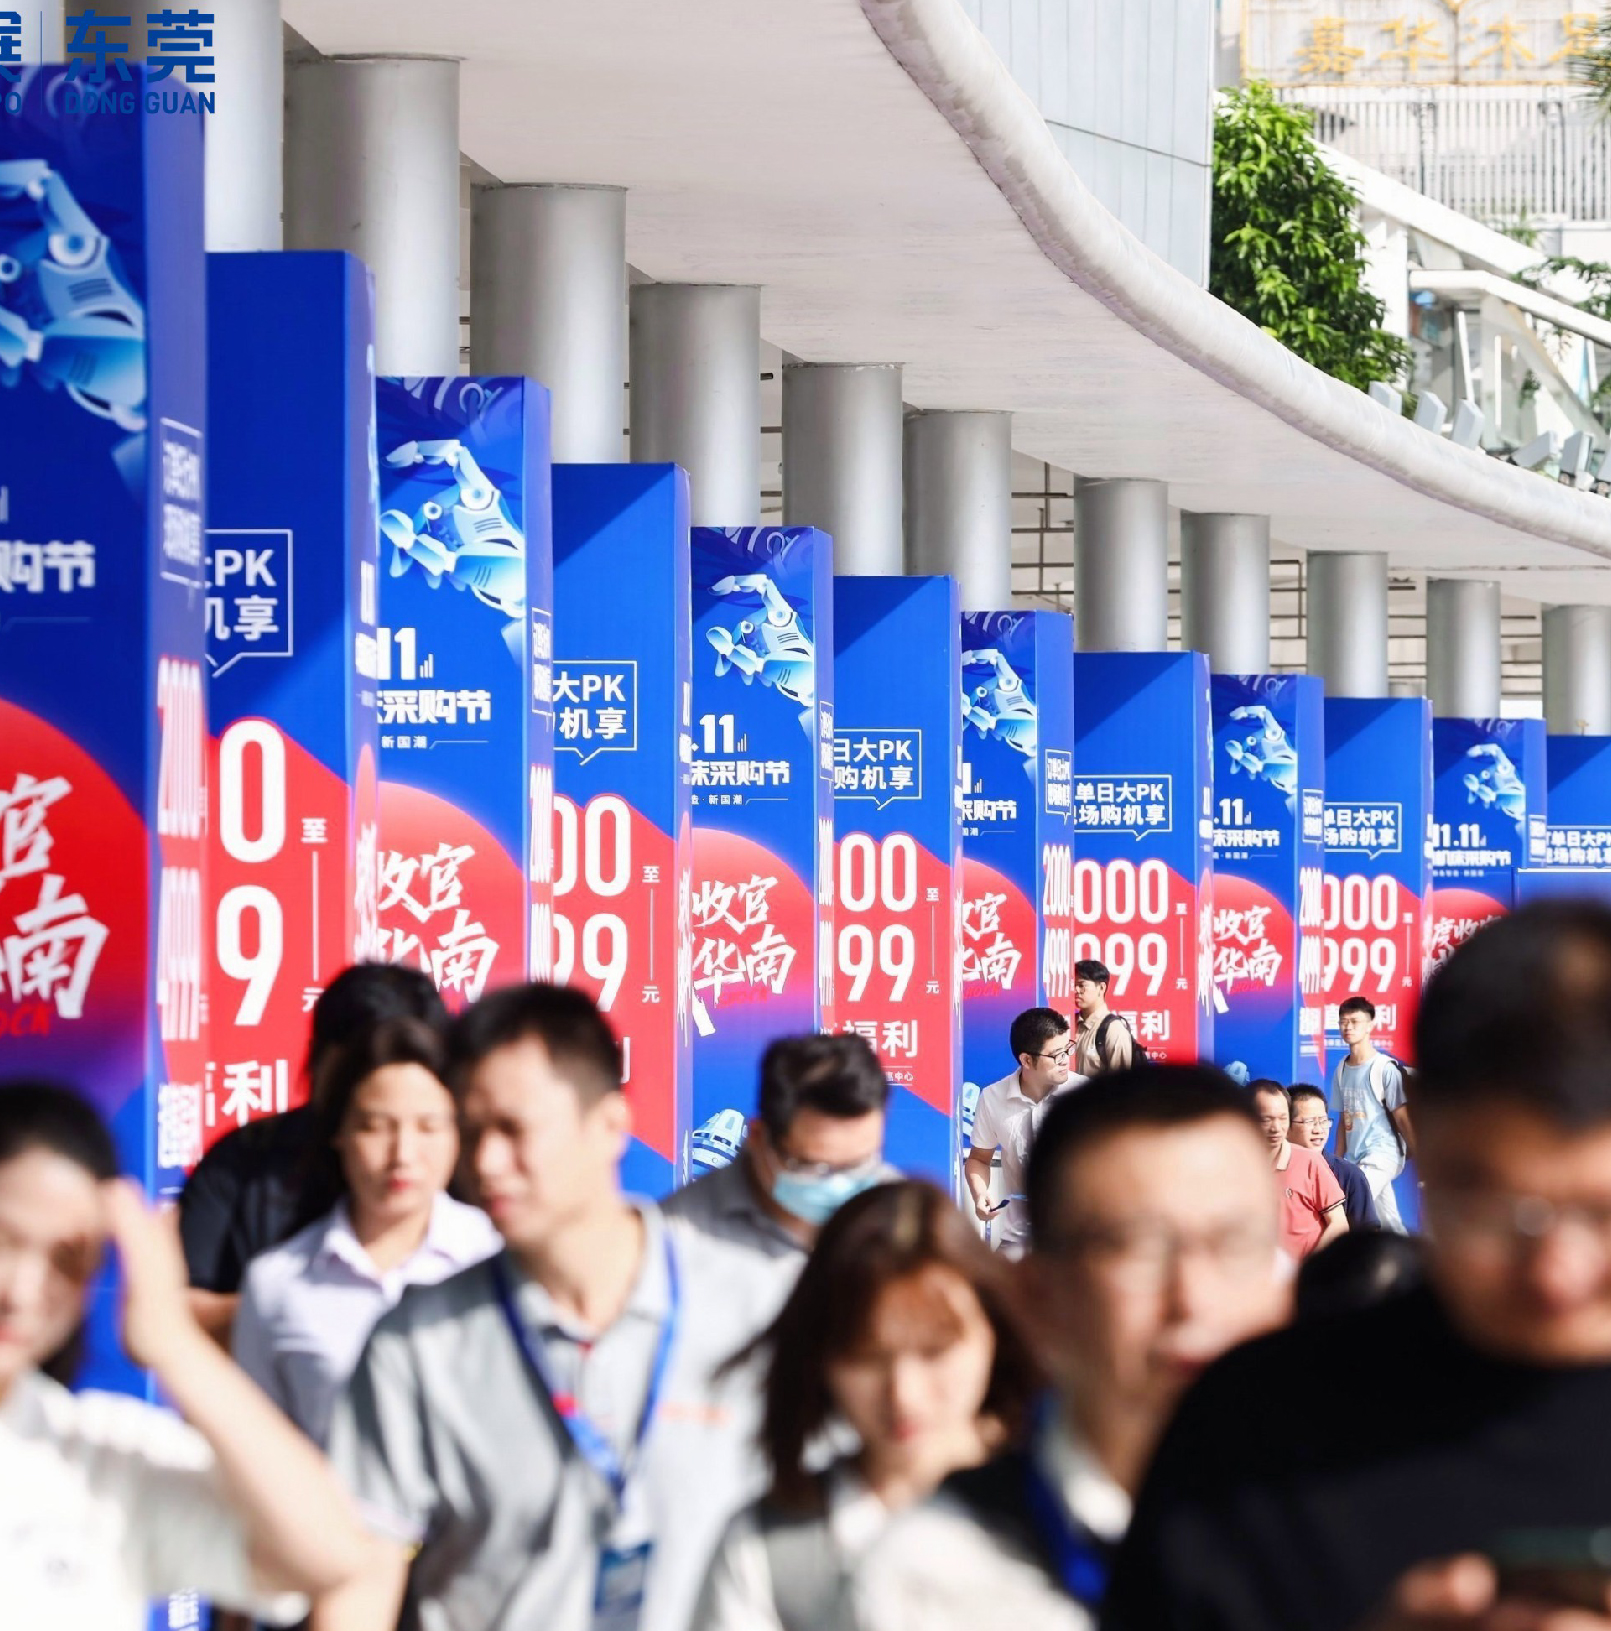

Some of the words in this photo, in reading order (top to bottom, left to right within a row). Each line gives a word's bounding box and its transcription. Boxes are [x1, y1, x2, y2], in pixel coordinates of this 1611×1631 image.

[205, 548, 277, 588] PK
[834, 765, 914, 791] 购机享
[1075, 782, 1165, 803] 单日大PK
[1074, 804, 1166, 826] 场购机享
[302, 818, 327, 844] 至
[642, 866, 660, 884] 至
[642, 986, 660, 1004] 元
